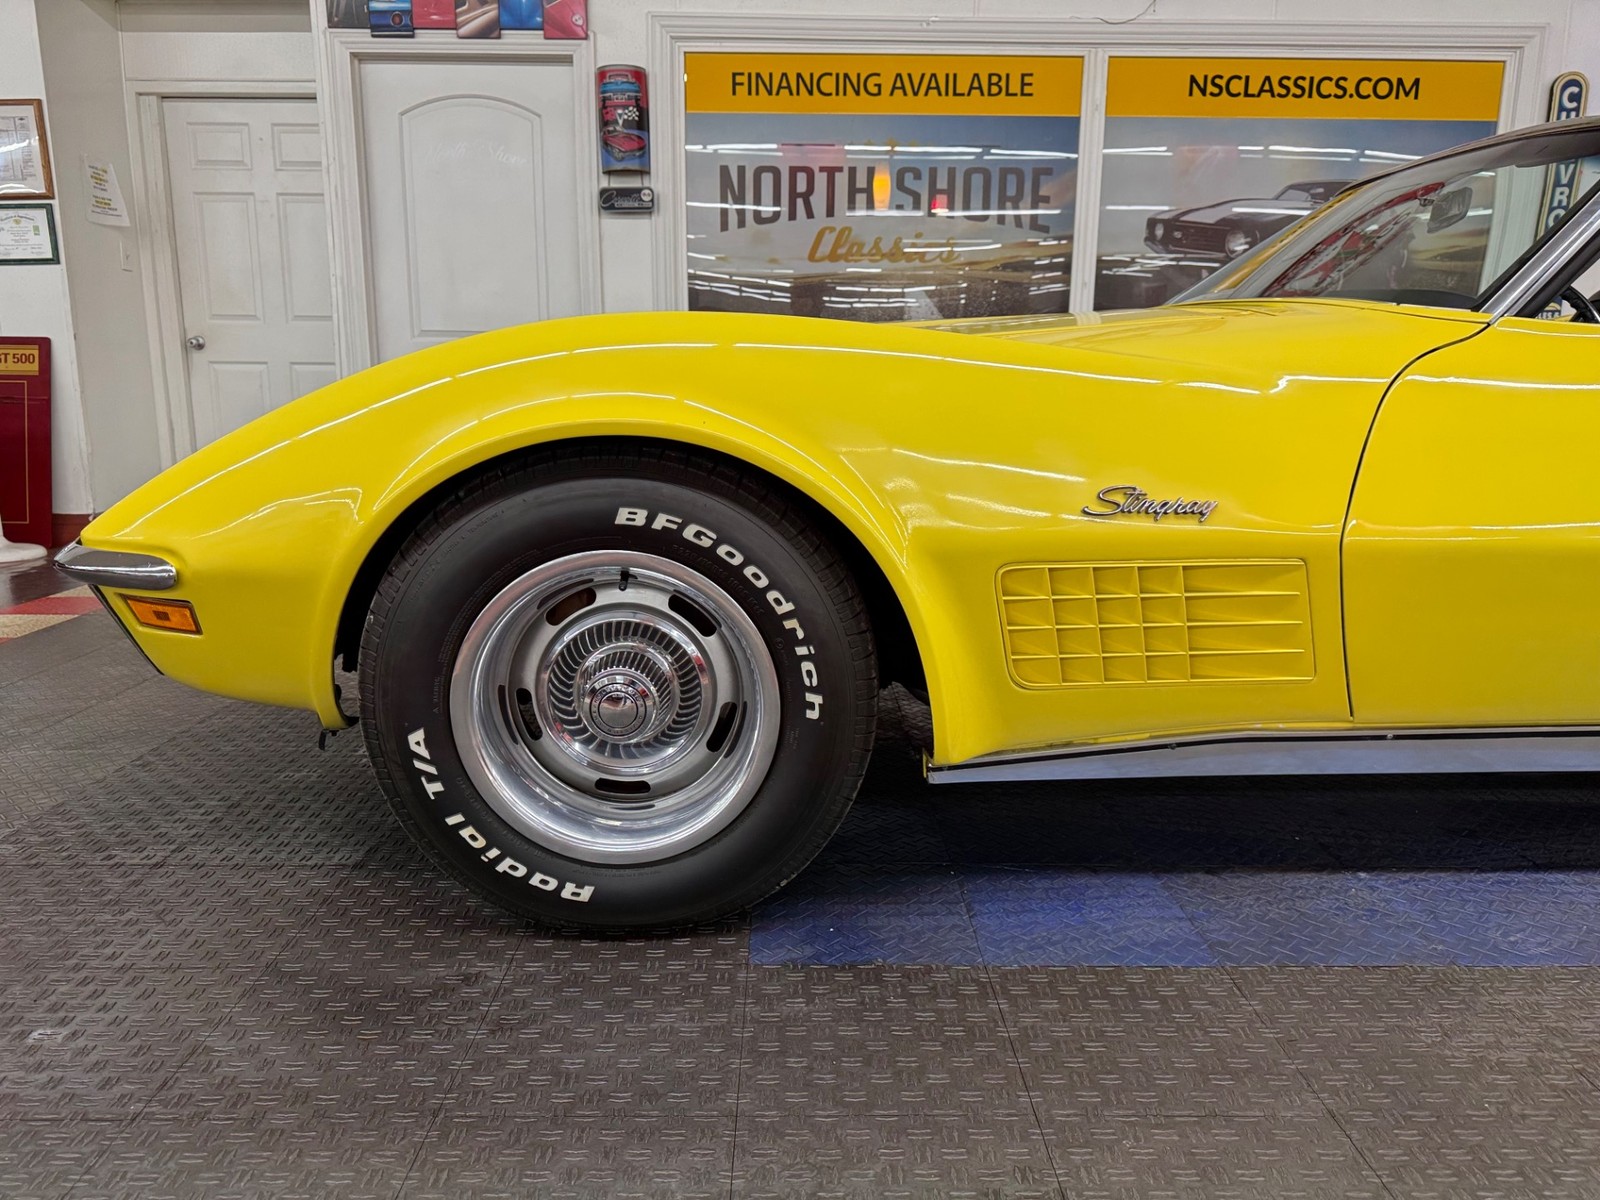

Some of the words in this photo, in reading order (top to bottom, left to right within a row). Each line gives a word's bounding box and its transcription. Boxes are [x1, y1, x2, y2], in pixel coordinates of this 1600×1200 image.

[731, 71, 883, 97] FINANCING
[889, 72, 1035, 97] AVAILABLE
[1187, 73, 1421, 101] NSCLASSICS.COM
[719, 163, 876, 233] NORTH
[895, 165, 1054, 235] SHORE
[807, 225, 960, 264] Classics
[12, 352, 36, 365] 500
[1081, 484, 1219, 523] Stingray
[614, 507, 824, 720] BFGoodrich
[407, 727, 445, 800] T/A
[444, 812, 596, 903] Radial
